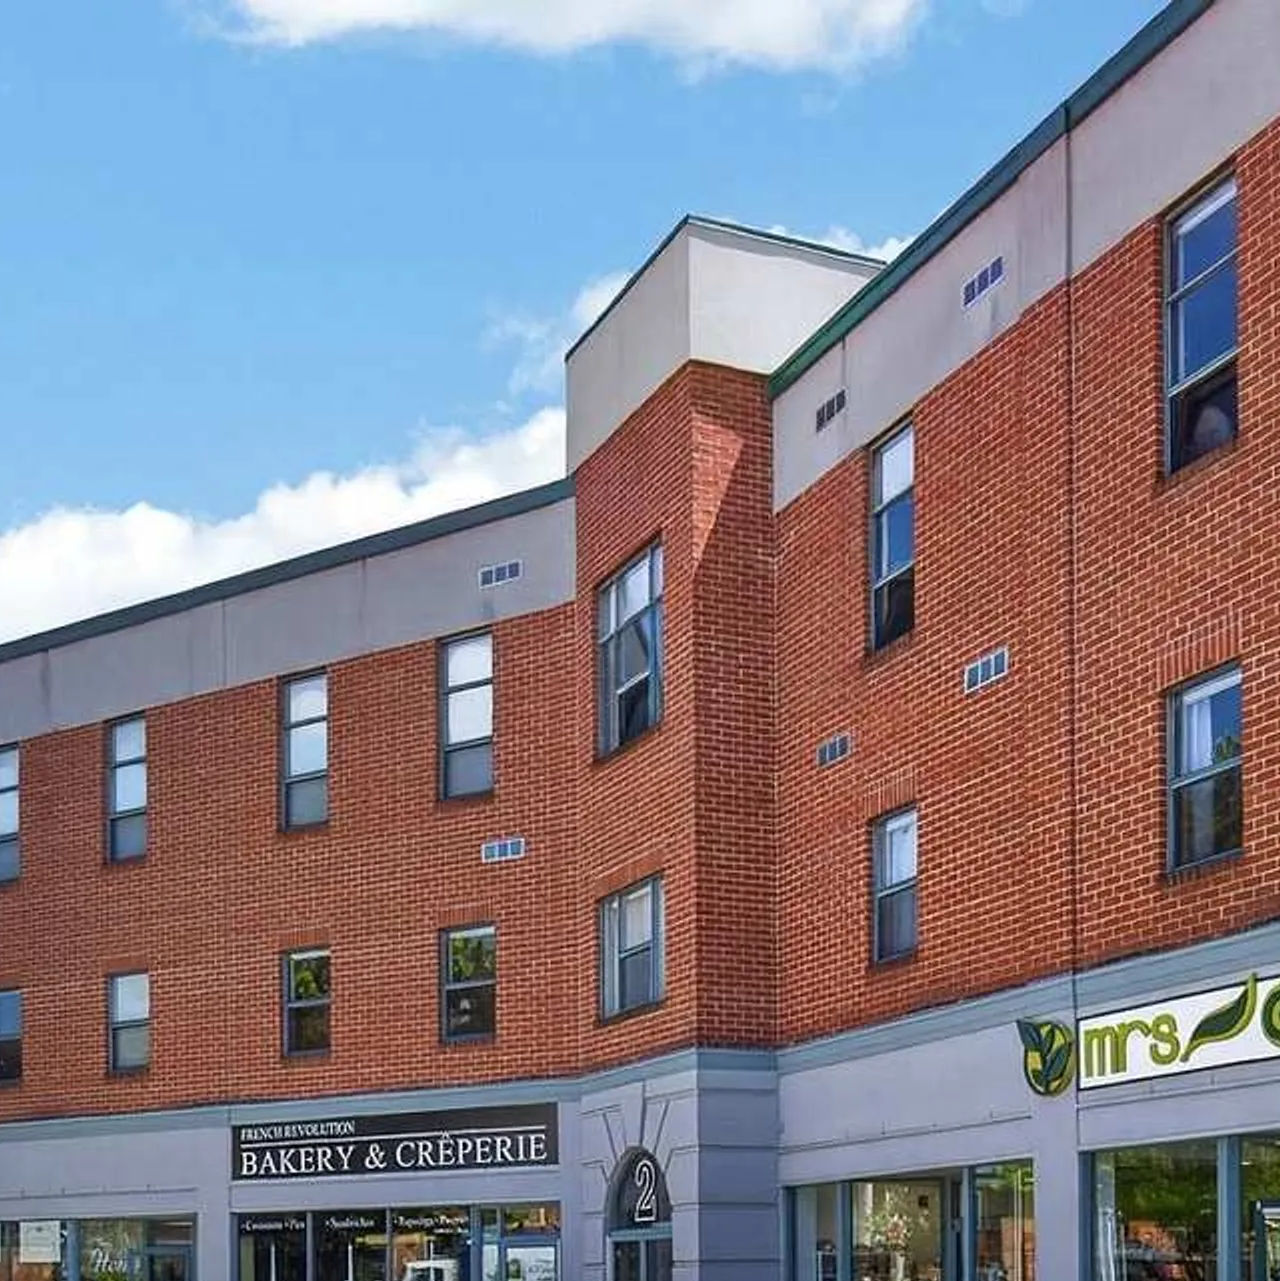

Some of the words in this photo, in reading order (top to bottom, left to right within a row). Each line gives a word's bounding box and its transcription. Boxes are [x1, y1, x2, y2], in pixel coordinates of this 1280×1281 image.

[1083, 1009, 1181, 1078] mrs
[240, 1126, 282, 1141] FRENCH
[284, 1120, 356, 1139] REVOLUTION
[241, 1145, 354, 1176] BAKERY
[364, 1144, 386, 1170] &
[395, 1131, 548, 1168] CRÊPERIE
[634, 1160, 656, 1222] 2
